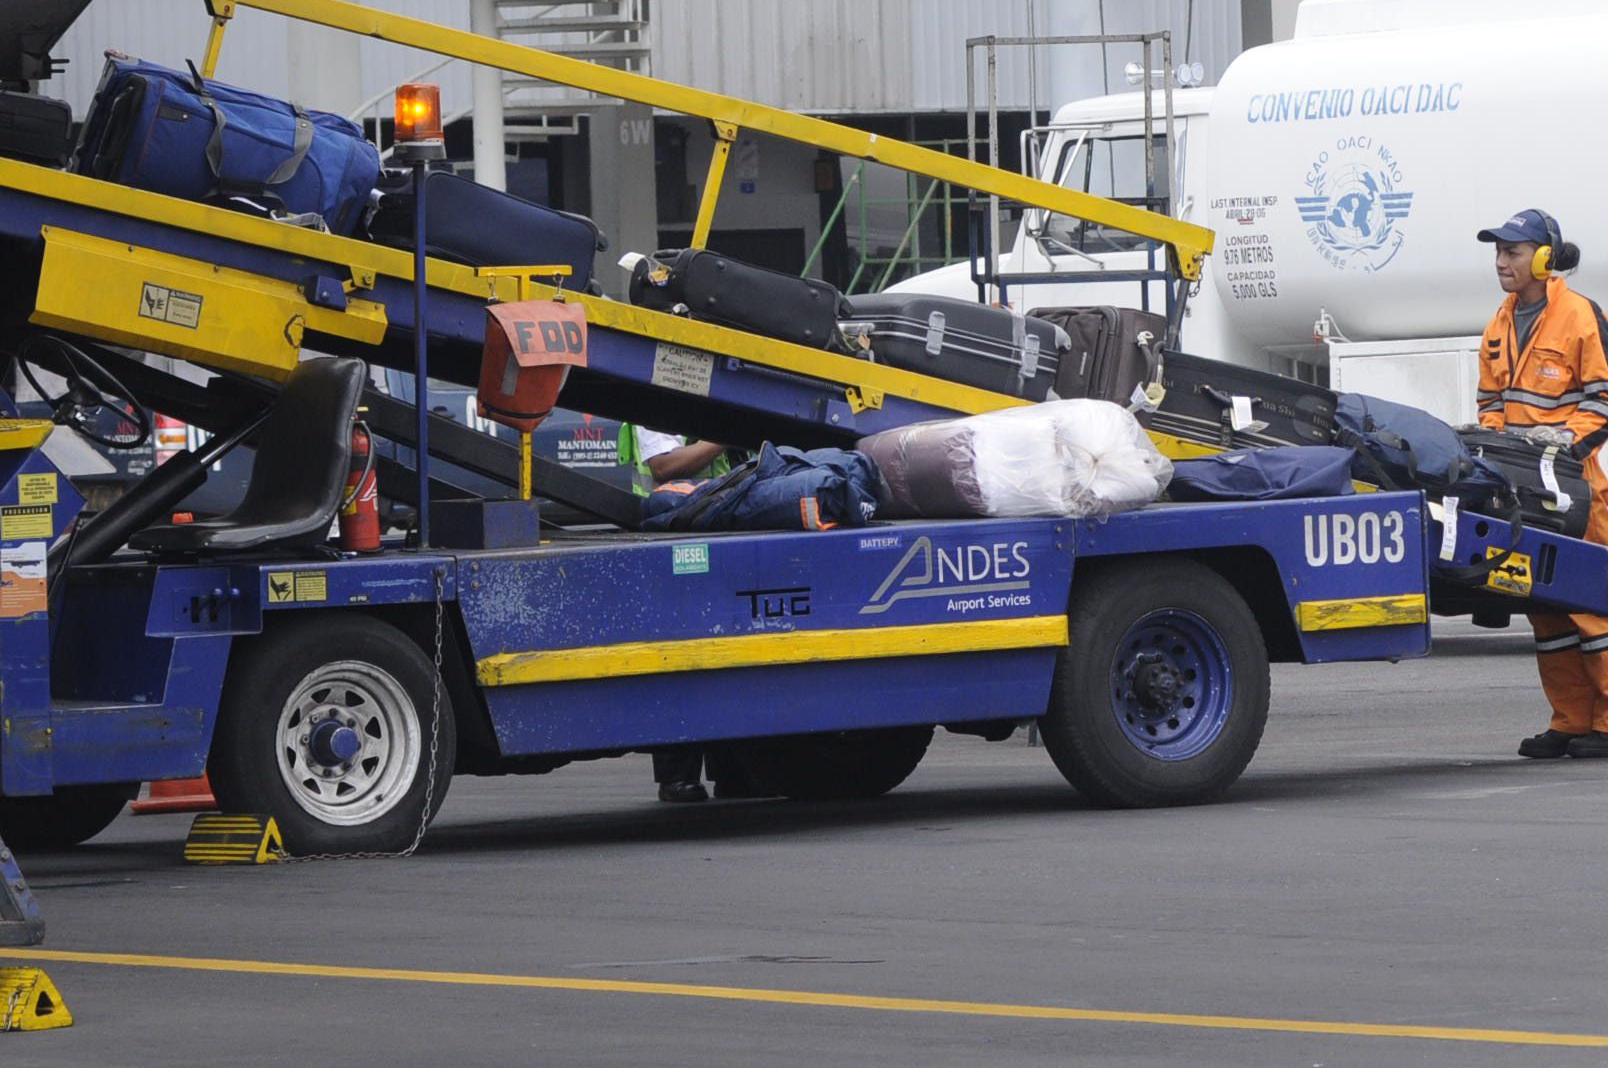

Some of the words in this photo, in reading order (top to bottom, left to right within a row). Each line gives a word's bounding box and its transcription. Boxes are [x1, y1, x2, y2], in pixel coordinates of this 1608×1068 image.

[1247, 89, 1354, 124] CONVENIO
[1360, 84, 1413, 116] OACI
[1415, 82, 1463, 113] DAC
[619, 119, 651, 145] 6W
[1336, 135, 1372, 151] OACI
[1210, 199, 1227, 209] LAST
[1229, 196, 1260, 208] INTERNAL
[1226, 235, 1269, 246] LONGITUD
[1241, 246, 1274, 264] METROS
[1227, 270, 1276, 282] CAPACIDAD
[1232, 284, 1257, 300] 5,000
[1258, 282, 1278, 298] GLS
[513, 320, 584, 354] FOD
[557, 440, 618, 450] MANTOMAIN
[860, 537, 899, 549] BATTERY
[1304, 511, 1404, 567] UB03
[675, 547, 706, 564] DIESEL
[736, 587, 811, 619] TUG
[947, 596, 985, 613] Airport
[988, 594, 1031, 608] Services
